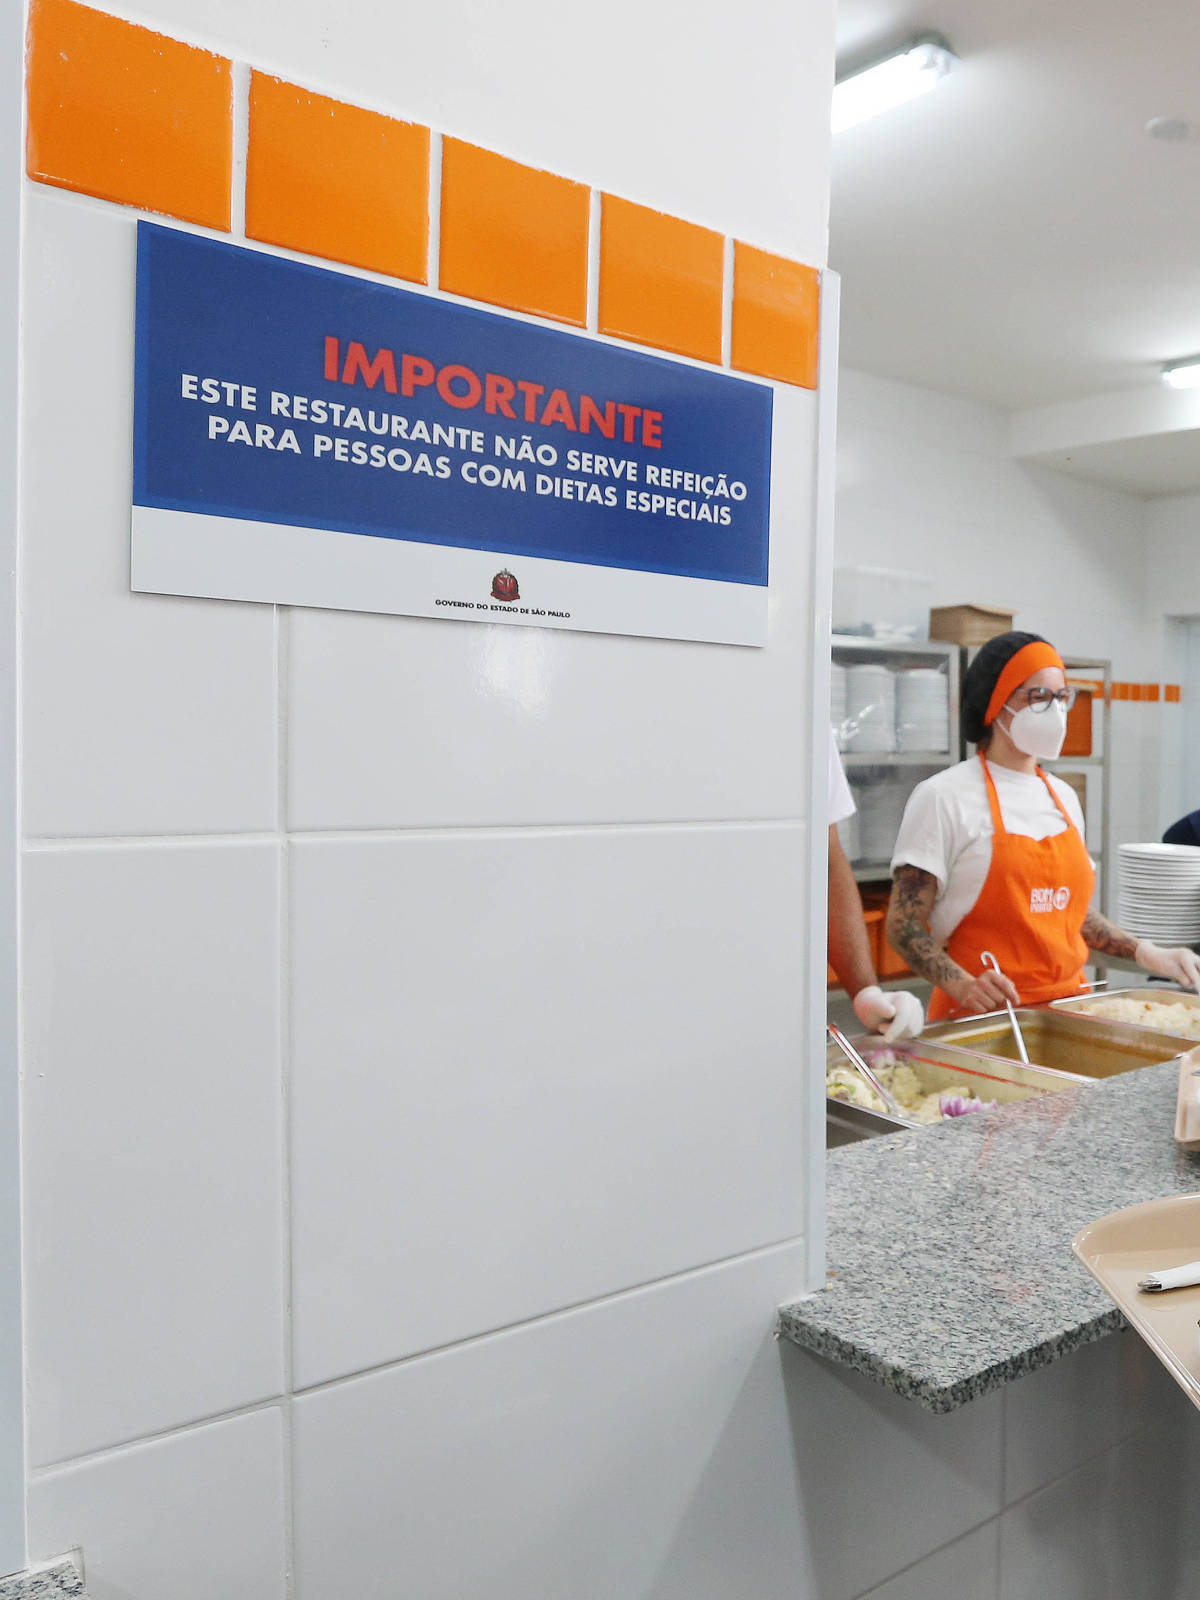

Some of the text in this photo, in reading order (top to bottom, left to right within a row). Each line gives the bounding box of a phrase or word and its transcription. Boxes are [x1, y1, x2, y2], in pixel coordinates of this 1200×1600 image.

[180, 373, 748, 502] ESTE RESTAURANTE NÃO SERVE REFEIÇÃO
[324, 335, 664, 450] IMPORTANTE
[208, 414, 733, 526] PARA PESSOAS COM DIETAS ESPECIAIS
[435, 599, 475, 609] GOVERNO
[476, 603, 488, 611] DO
[490, 605, 519, 613] ESTADO
[531, 607, 546, 616] SÃO
[548, 610, 571, 618] PAULO
